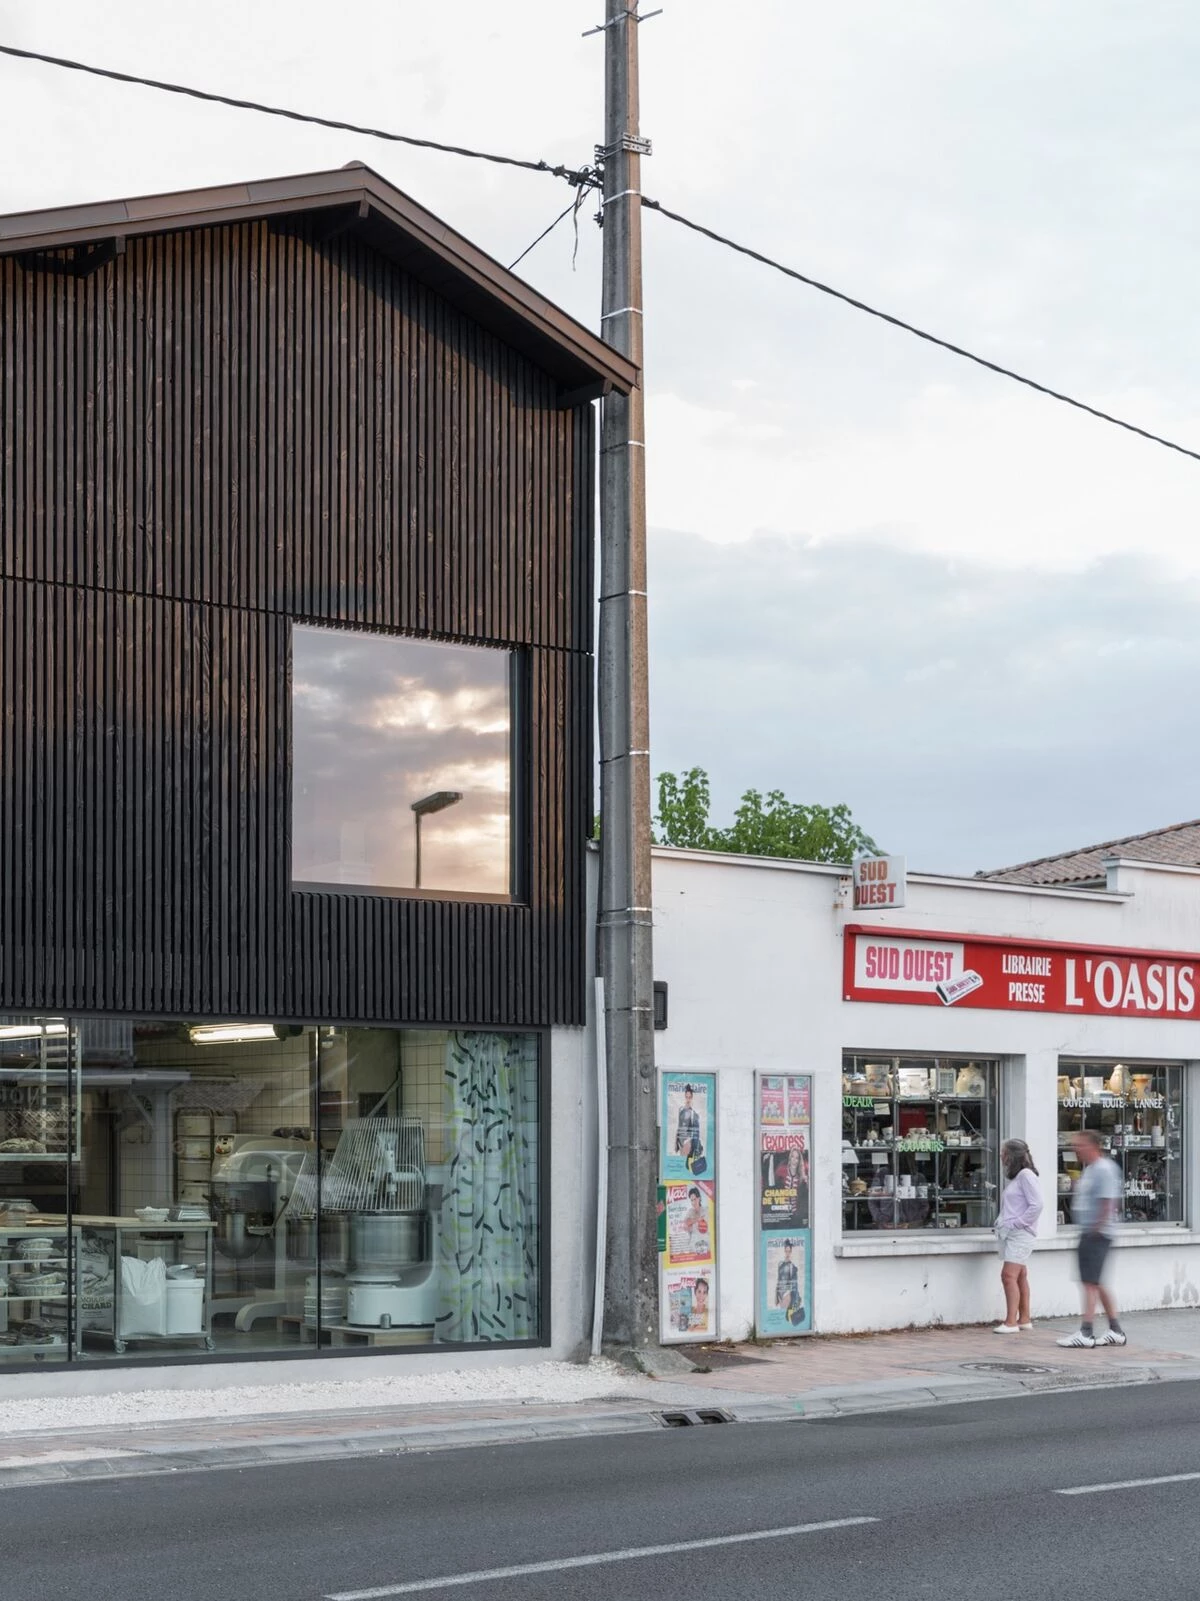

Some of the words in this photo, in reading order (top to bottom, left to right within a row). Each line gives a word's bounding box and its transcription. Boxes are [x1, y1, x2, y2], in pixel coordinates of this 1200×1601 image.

[860, 861, 888, 882] SUD
[855, 883, 896, 906] OUEST
[866, 946, 900, 980] SUD
[903, 948, 953, 982] OUEST
[1002, 954, 1052, 977] LIBRAIRIE
[1008, 982, 1046, 1004] PRESSE
[1065, 958, 1195, 1012] L'OASIS
[842, 1095, 874, 1107] ADEAUX
[1062, 1097, 1091, 1108] OUVERT
[1102, 1097, 1124, 1108] TOUTE
[899, 1141, 944, 1152] SOUVENIRS
